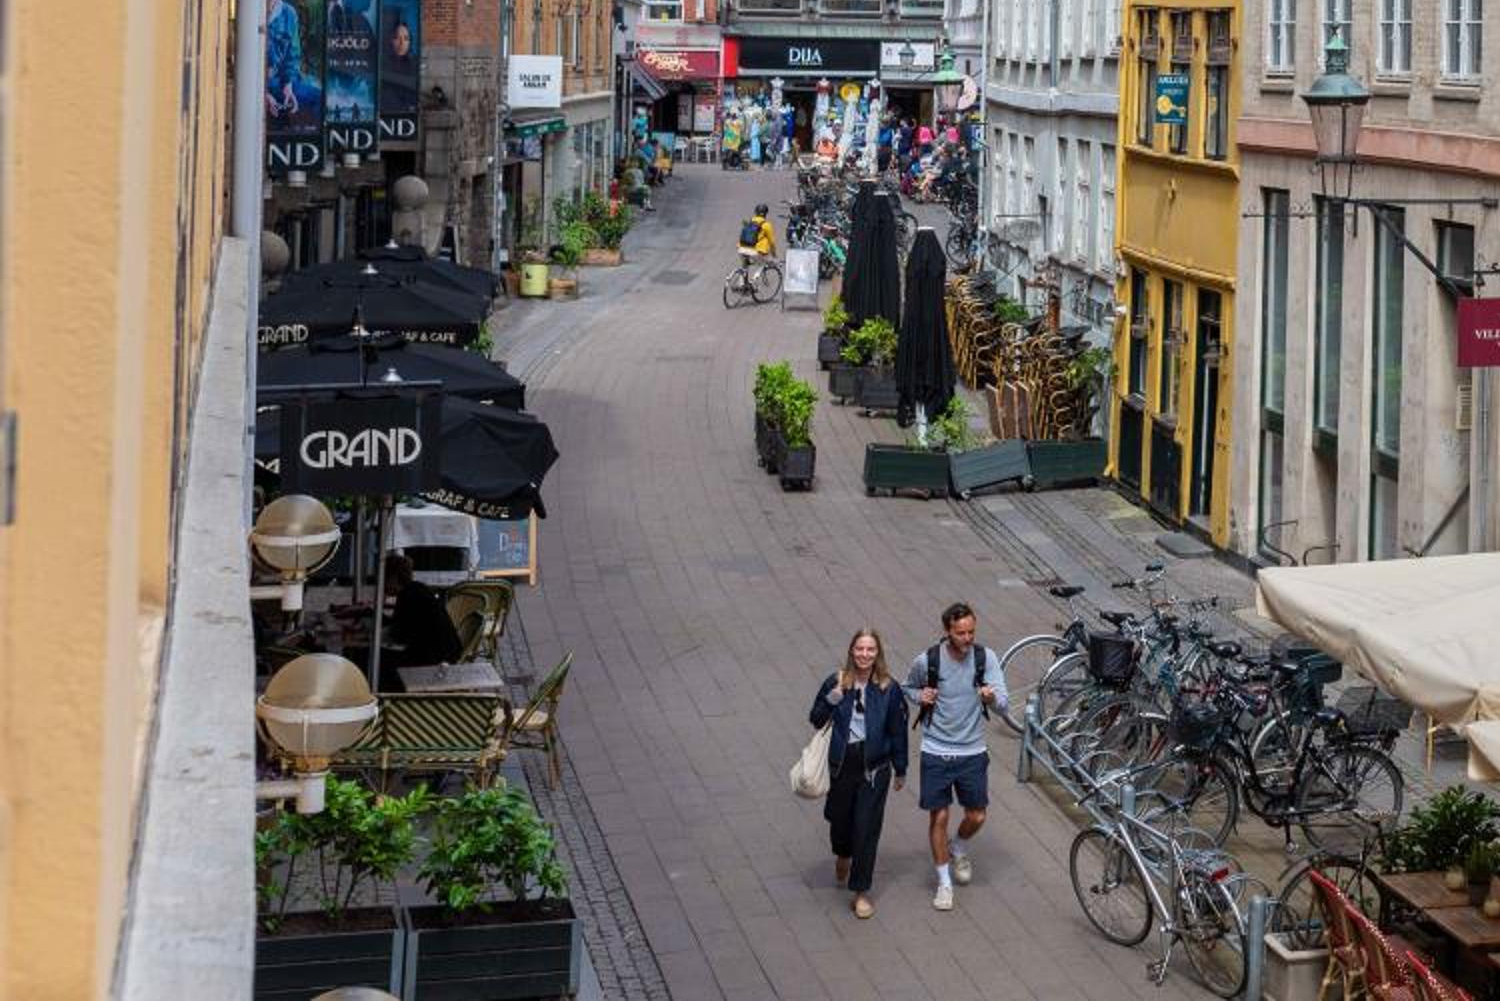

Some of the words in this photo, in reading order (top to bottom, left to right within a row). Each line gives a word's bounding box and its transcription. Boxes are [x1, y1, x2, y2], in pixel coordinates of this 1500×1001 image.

[379, 118, 416, 136] ND
[329, 129, 373, 150] ND
[268, 142, 319, 166] ND
[300, 427, 422, 468] GRAND
